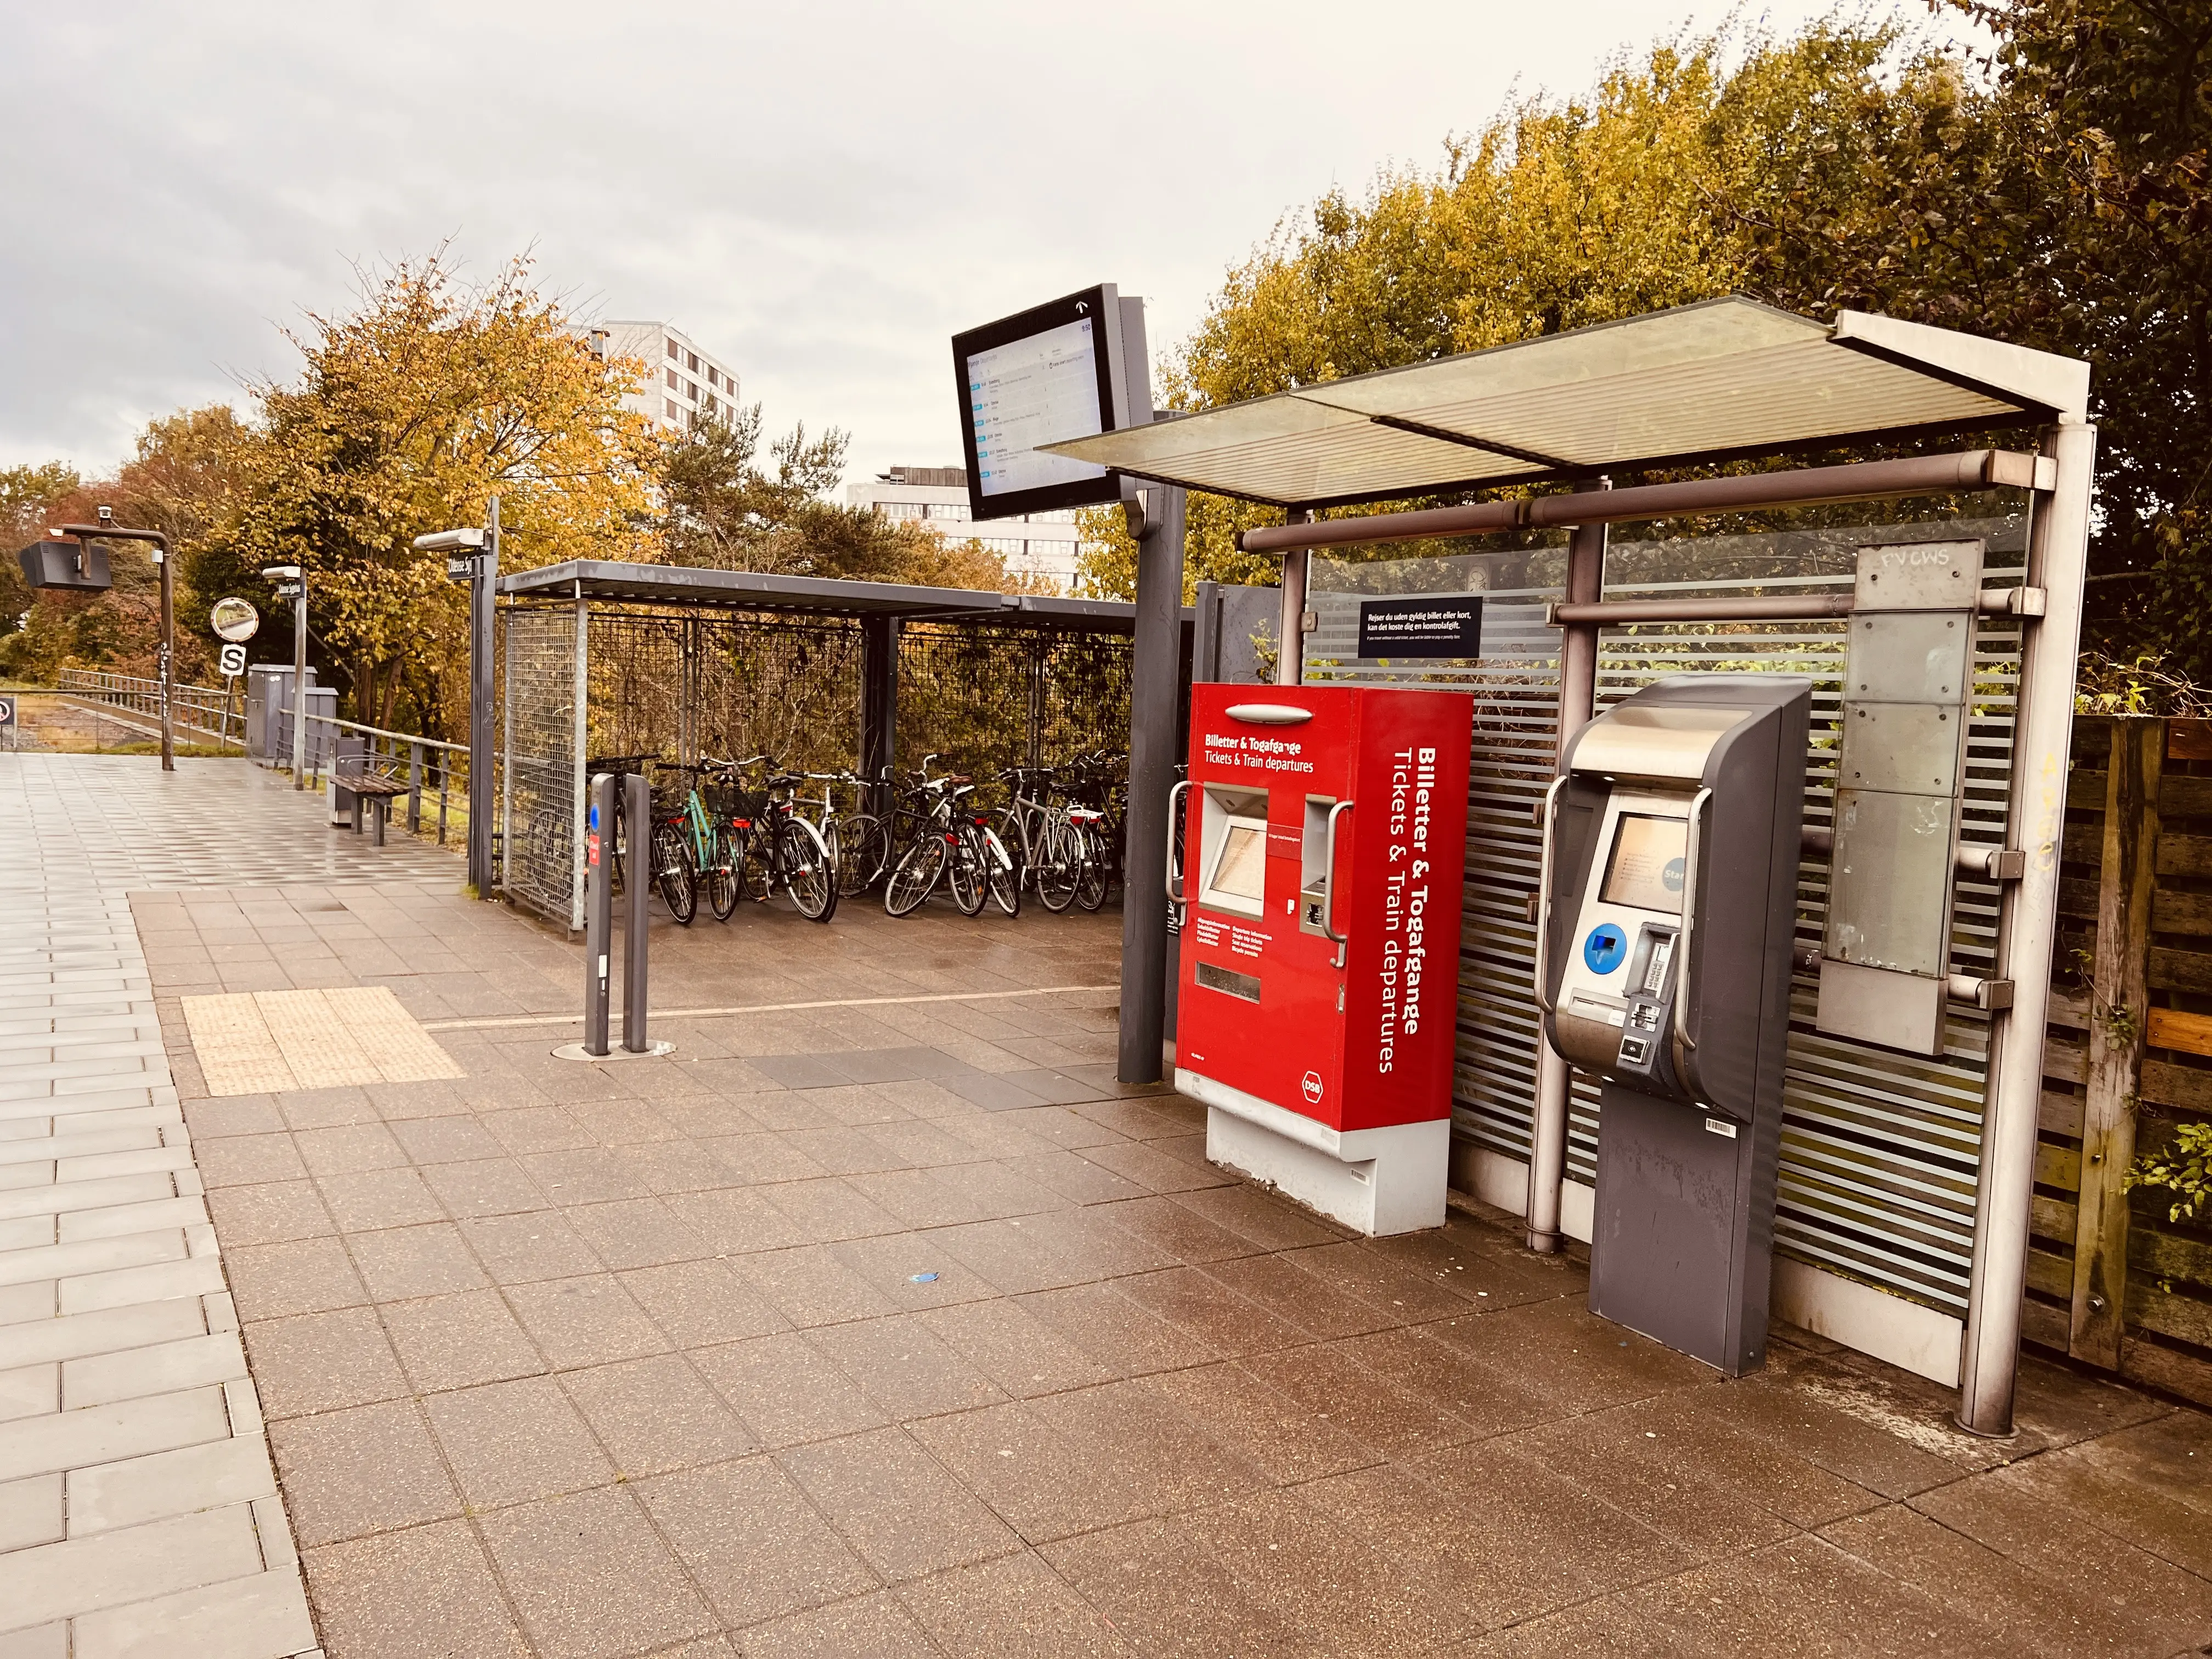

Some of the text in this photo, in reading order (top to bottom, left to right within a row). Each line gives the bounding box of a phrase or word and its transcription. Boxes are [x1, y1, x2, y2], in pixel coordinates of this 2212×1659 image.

[449, 557, 465, 573] Odense
[1368, 614, 1385, 622] Rejser
[1408, 612, 1426, 621] gyldig
[1457, 611, 1471, 619] kort,
[1404, 622, 1413, 631] dig
[1423, 621, 1460, 630] kontrolafgift.
[223, 649, 243, 671] S
[1205, 734, 1239, 748] Billetter
[1240, 737, 1248, 749] &
[1205, 751, 1313, 773] Tickets & Train departures
[1664, 870, 1684, 880] Star
[1402, 748, 1436, 1035] Billetter & Togafgange
[1379, 747, 1412, 1074] Tickets & Train departures
[1305, 1080, 1321, 1094] DSB
